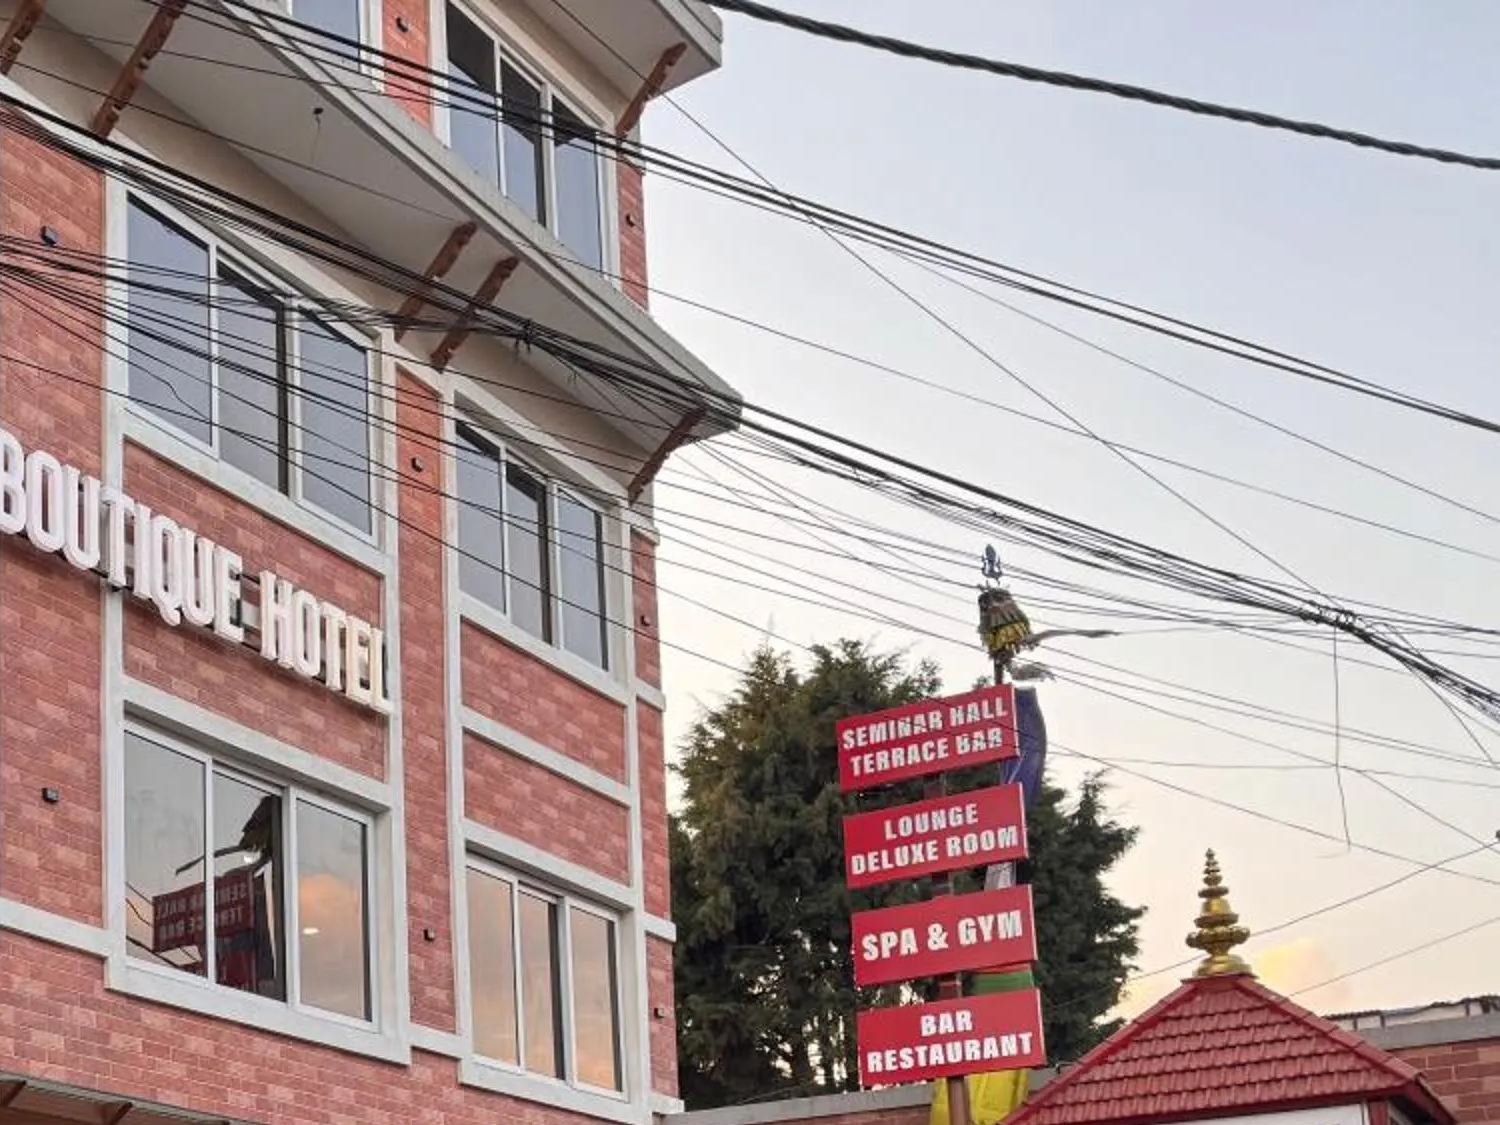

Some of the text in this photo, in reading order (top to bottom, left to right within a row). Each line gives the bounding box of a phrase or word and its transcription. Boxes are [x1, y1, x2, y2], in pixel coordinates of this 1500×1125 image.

[258, 569, 394, 713] HOTEL
[841, 696, 1008, 750] SEMINAR HALL
[850, 726, 1004, 777] TERRACE BAR
[883, 803, 979, 841] LOUNGE
[850, 825, 1019, 875] DELUXE ROOM
[861, 908, 1024, 962] SPA & GYM
[920, 1008, 973, 1038] BAR
[866, 1031, 1033, 1074] RESTAURANT
